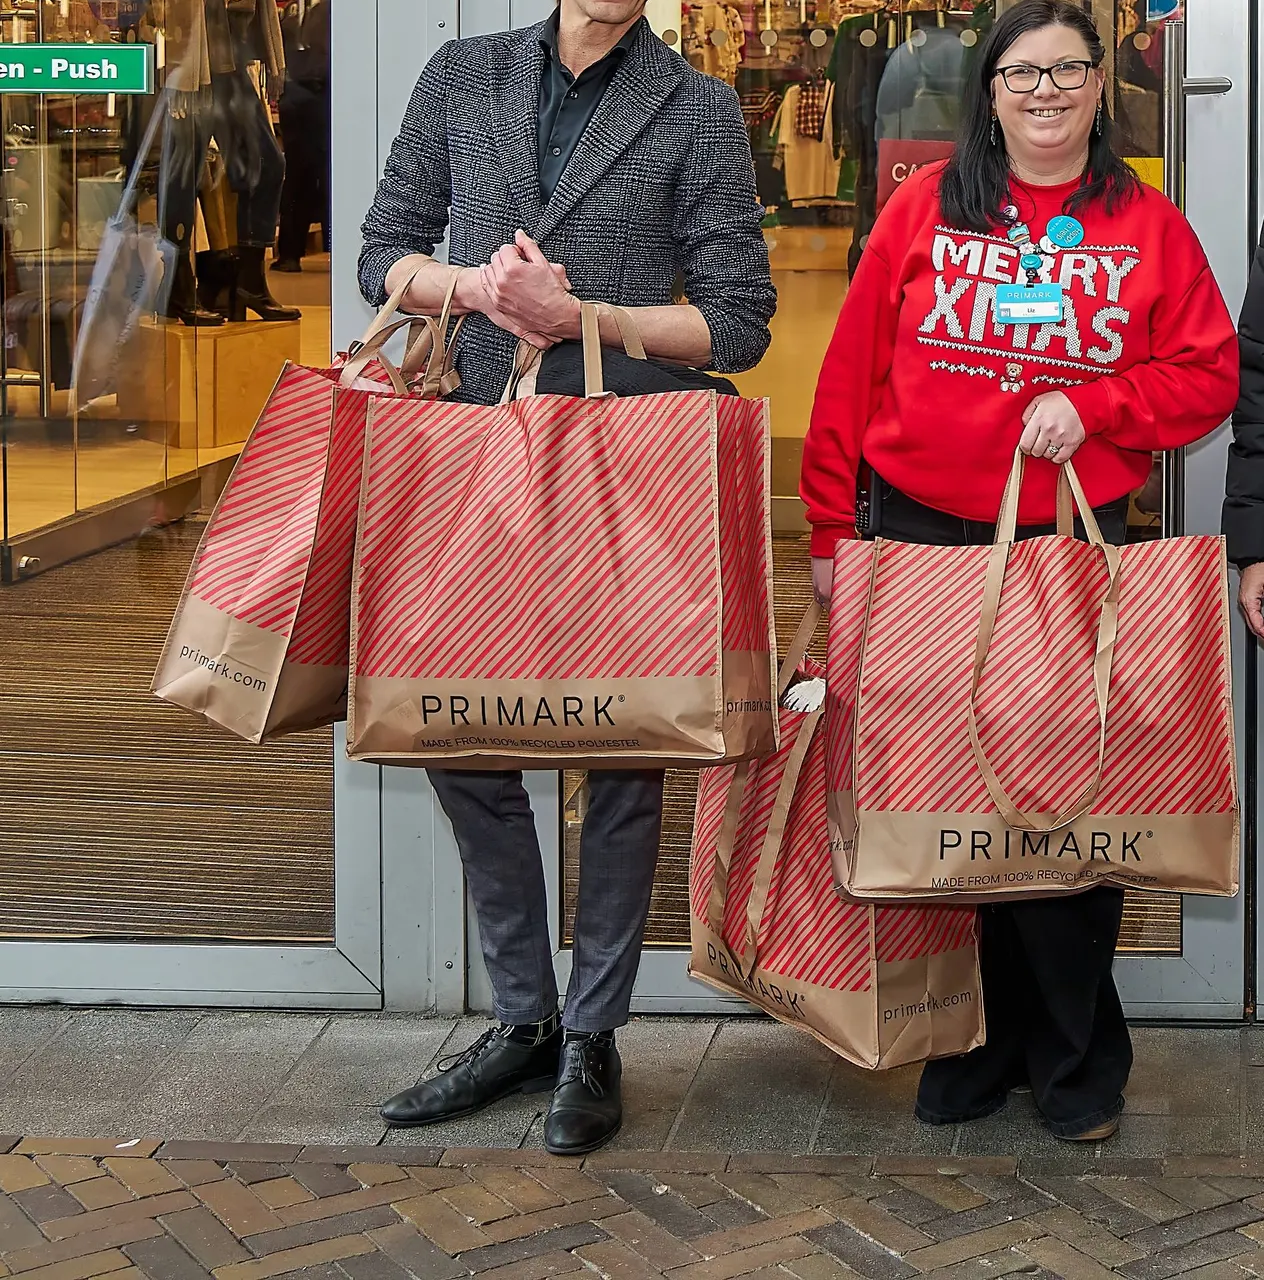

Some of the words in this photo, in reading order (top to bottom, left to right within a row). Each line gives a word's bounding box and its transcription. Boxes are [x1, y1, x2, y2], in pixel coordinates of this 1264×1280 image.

[51, 58, 118, 79] Push
[931, 234, 1141, 303] MERRY
[1006, 291, 1052, 299] PRIMARK
[918, 274, 1130, 365] XMAS
[180, 644, 267, 692] primark.com
[421, 738, 452, 748] MADE
[455, 736, 488, 746] FROM
[489, 738, 519, 747] 100%
[520, 739, 576, 749] RECYCLED
[578, 739, 640, 749] POLYESTER
[931, 877, 964, 889] MADE
[967, 875, 1001, 887] FROM
[1003, 871, 1034, 883] 100%
[883, 990, 972, 1024] primark.com
